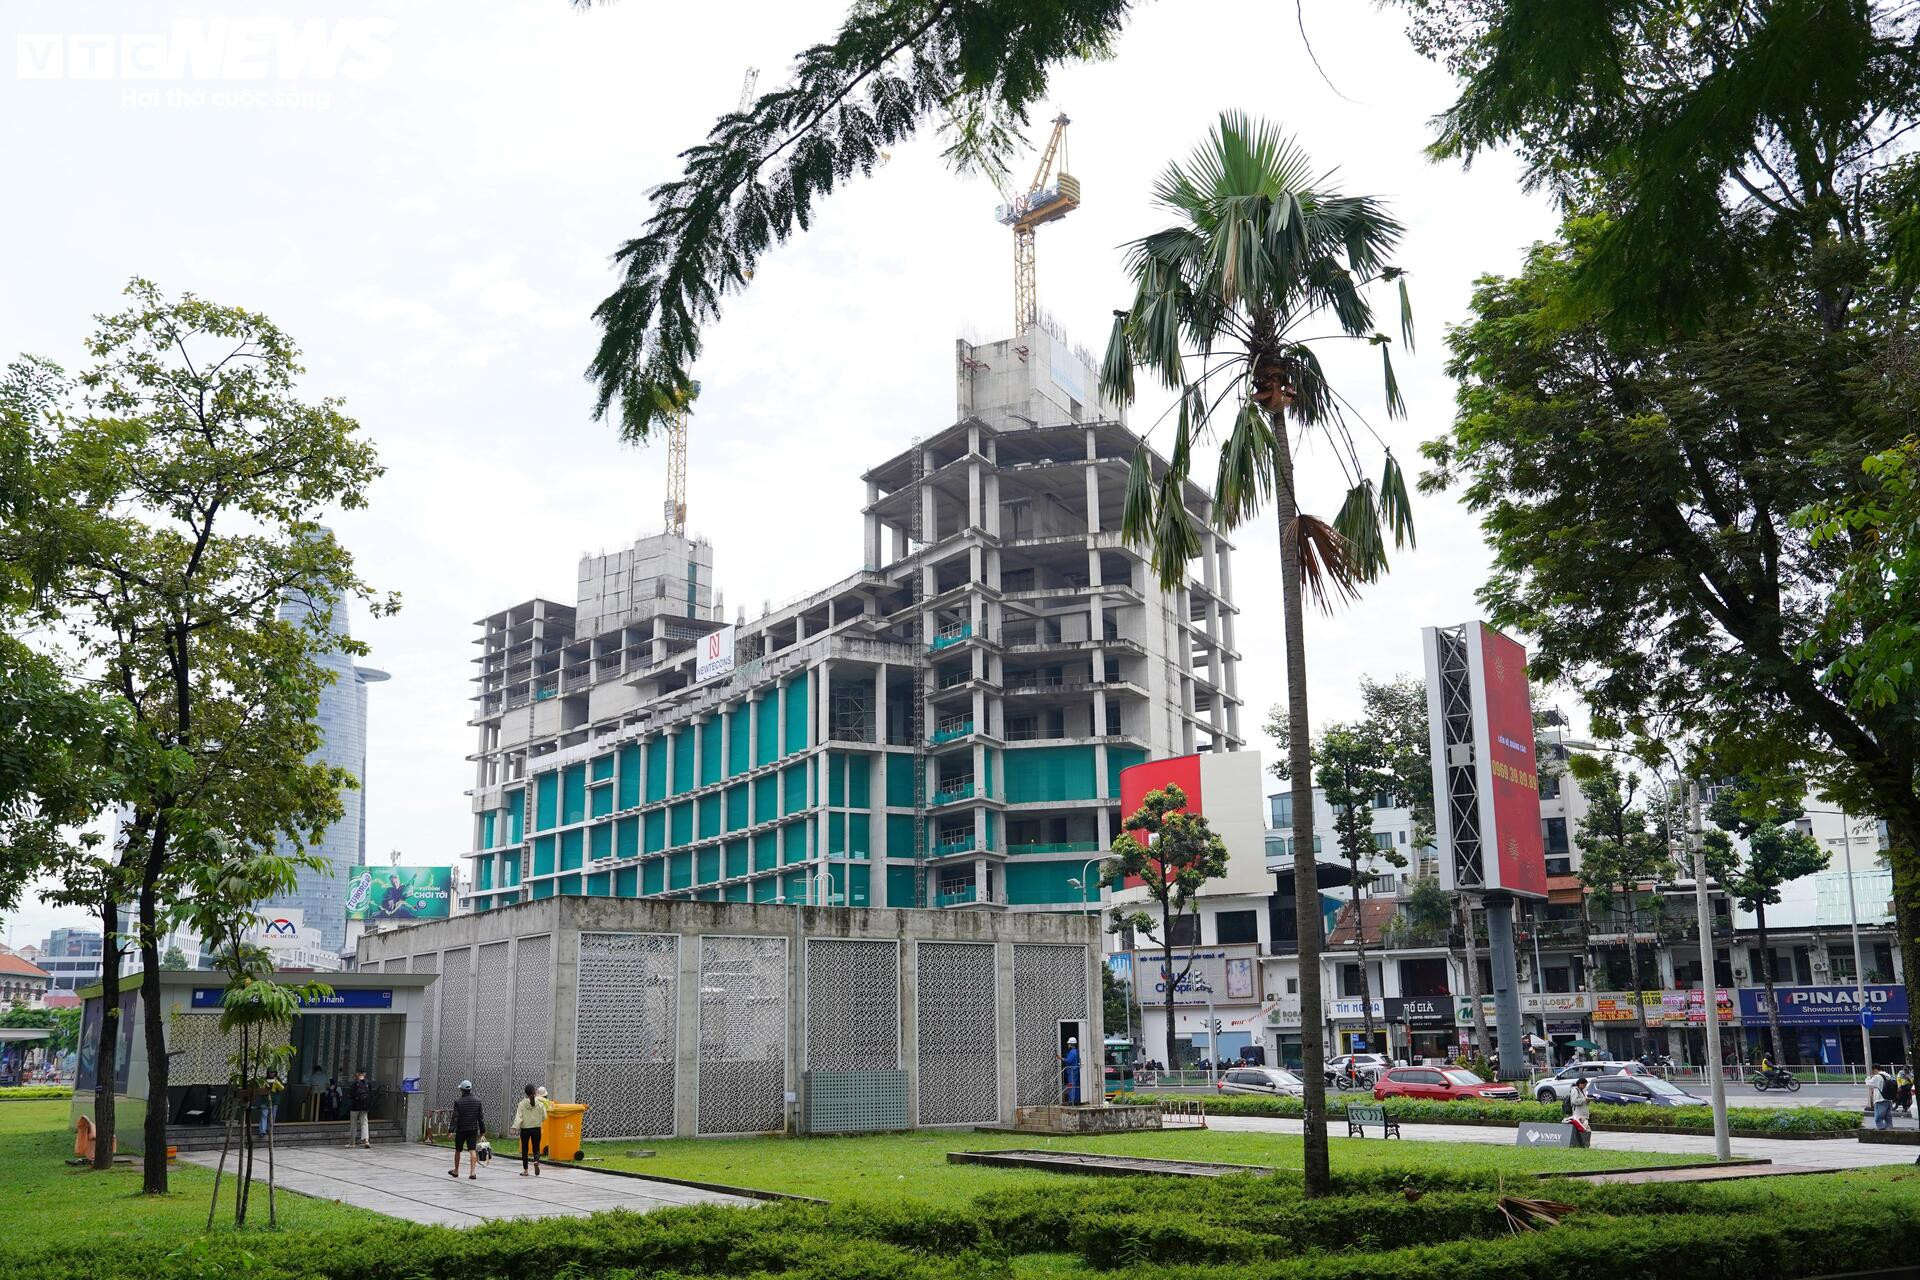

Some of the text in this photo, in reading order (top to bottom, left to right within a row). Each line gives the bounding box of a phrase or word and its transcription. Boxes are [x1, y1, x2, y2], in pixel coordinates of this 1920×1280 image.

[696, 656, 731, 676] NEWTECONS
[347, 880, 369, 908] TUBORG
[322, 995, 345, 1004] Thanh
[1539, 997, 1568, 1005] LOSET
[1792, 990, 1888, 1004] PINACO
[1417, 1000, 1434, 1013] GIÀ
[1802, 1005, 1843, 1013] Showroom
[1540, 1132, 1562, 1140] VNPAY
